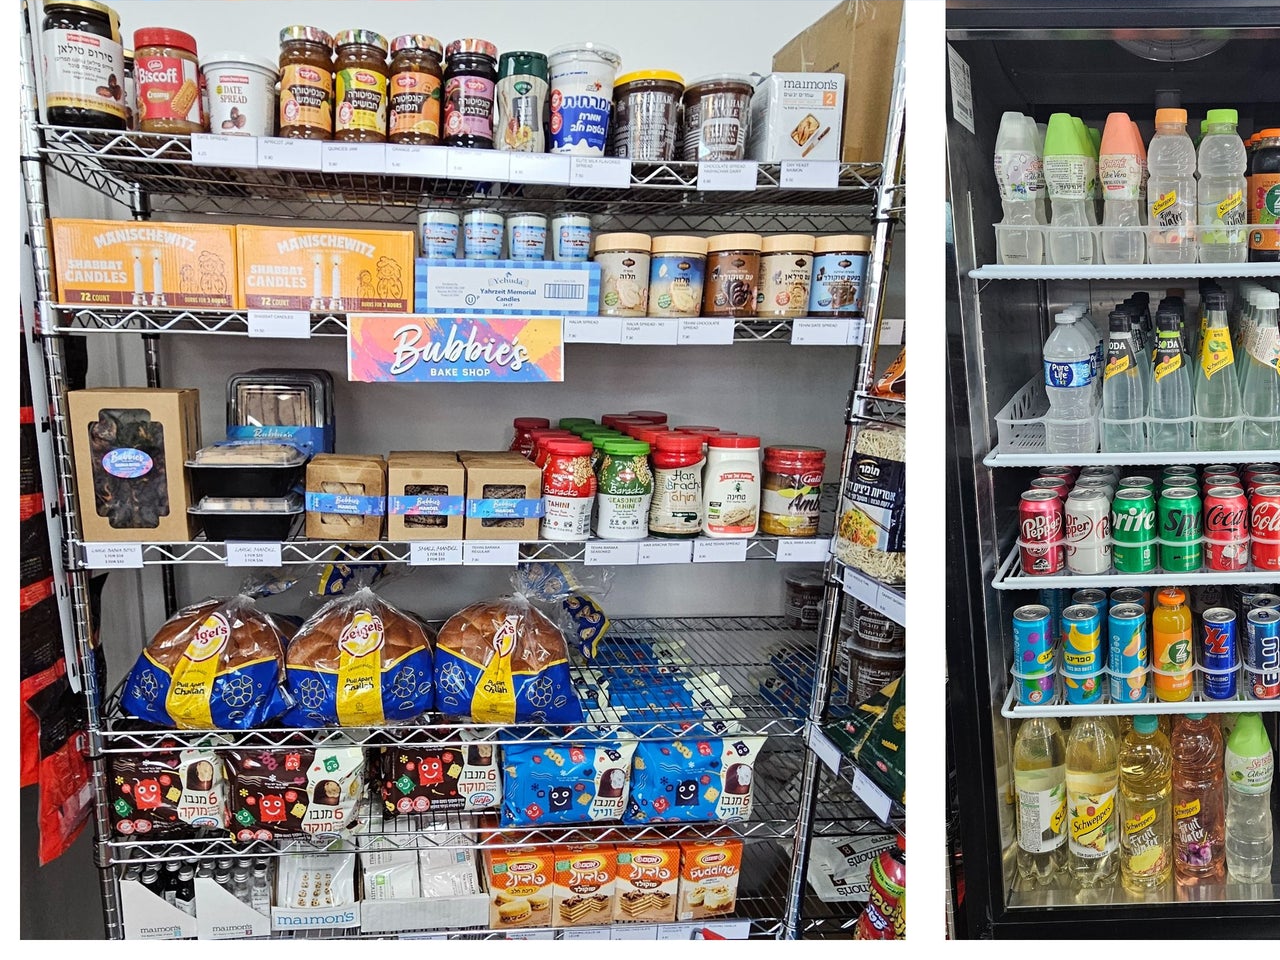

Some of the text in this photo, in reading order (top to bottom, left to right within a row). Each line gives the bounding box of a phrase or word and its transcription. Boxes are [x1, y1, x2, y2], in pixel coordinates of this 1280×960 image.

[138, 68, 178, 84] Biscoff
[223, 85, 243, 95] DATE
[220, 94, 248, 104] SPREAD
[94, 229, 196, 252] MANISCHEWITZ
[276, 234, 377, 259] MANISCHEWITZ
[67, 259, 123, 271] SHABBAT
[65, 270, 127, 284] CANDLES
[247, 274, 307, 288] CANDLES
[493, 276, 524, 287] Yehuda
[80, 292, 111, 303] 72 COUNT
[480, 289, 537, 298] Yahrzeit Memorial
[391, 324, 530, 375] Bubbie's
[431, 368, 490, 376] BAKE SHOP
[1052, 364, 1069, 372] Pure
[548, 500, 570, 508] TAHINI
[1205, 626, 1229, 653] XL
[1205, 674, 1230, 682] CLASSIC
[309, 810, 332, 819] מנבו
